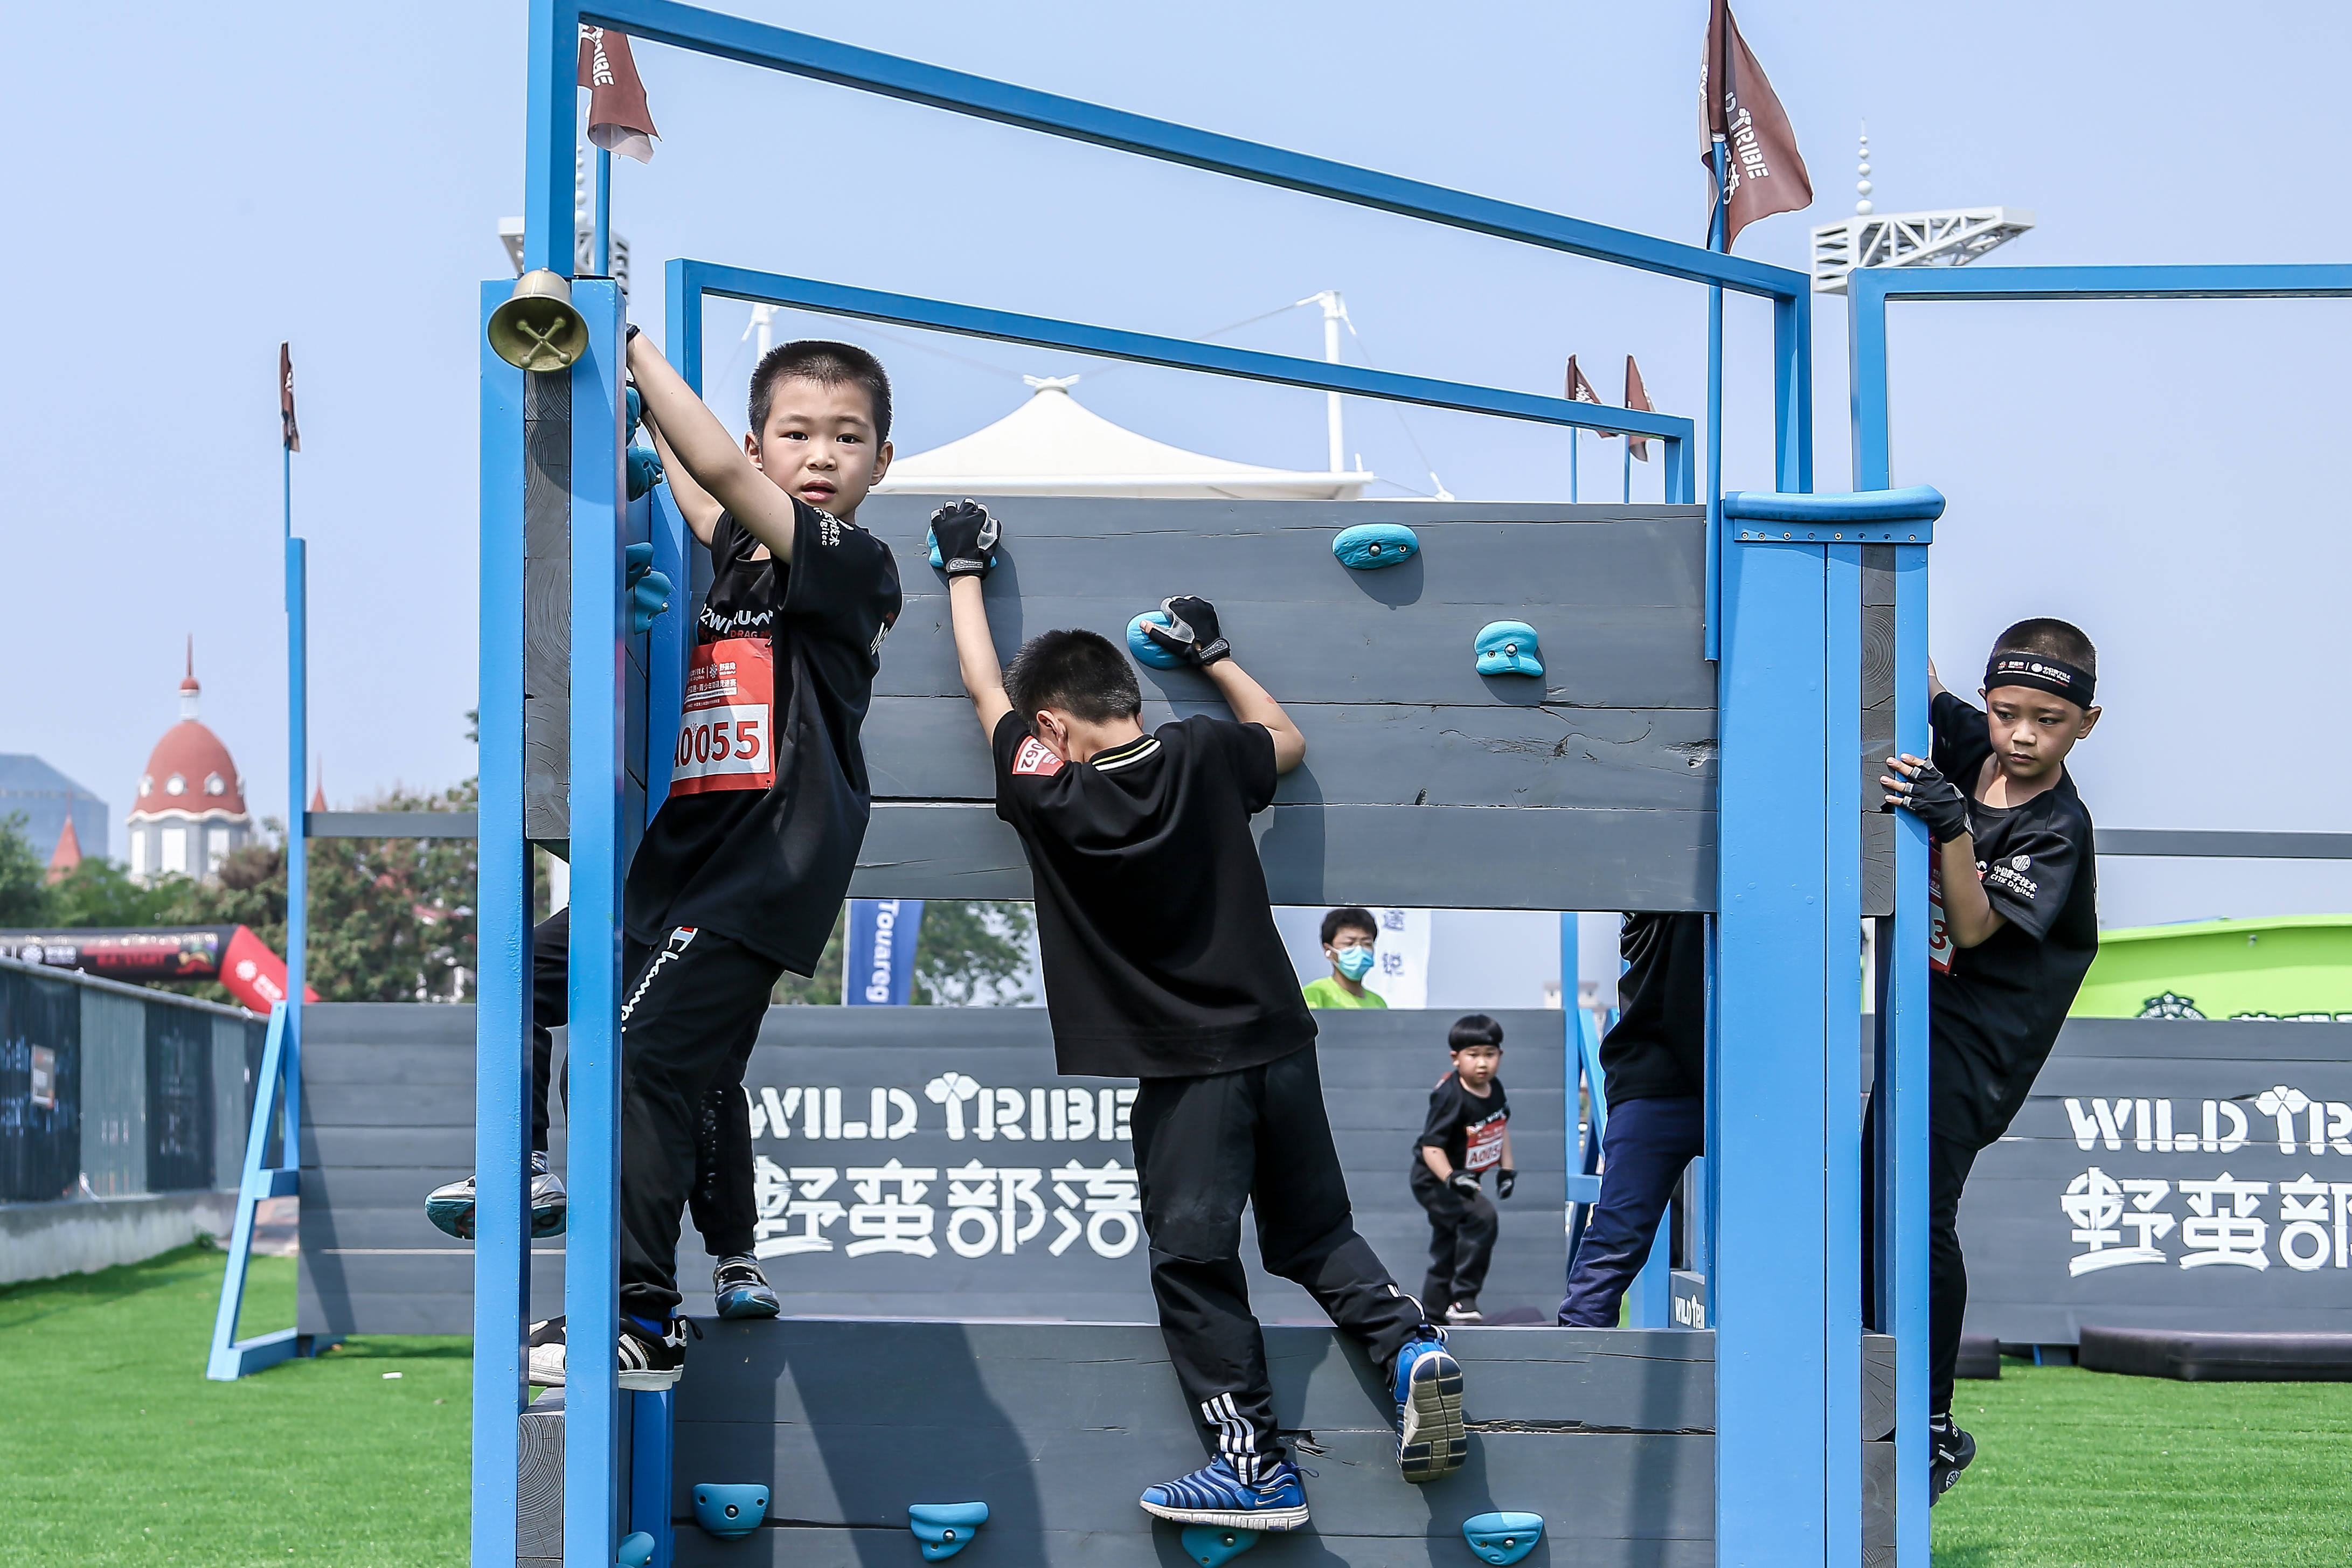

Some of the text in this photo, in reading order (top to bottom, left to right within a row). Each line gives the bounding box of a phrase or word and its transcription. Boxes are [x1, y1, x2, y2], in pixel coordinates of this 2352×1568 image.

[750, 1071, 1140, 1142] WILD TRIBE
[2063, 1097, 2250, 1154] WILD
[754, 1154, 1141, 1261] 野蛮部落
[1675, 1296, 1691, 1326] WILD
